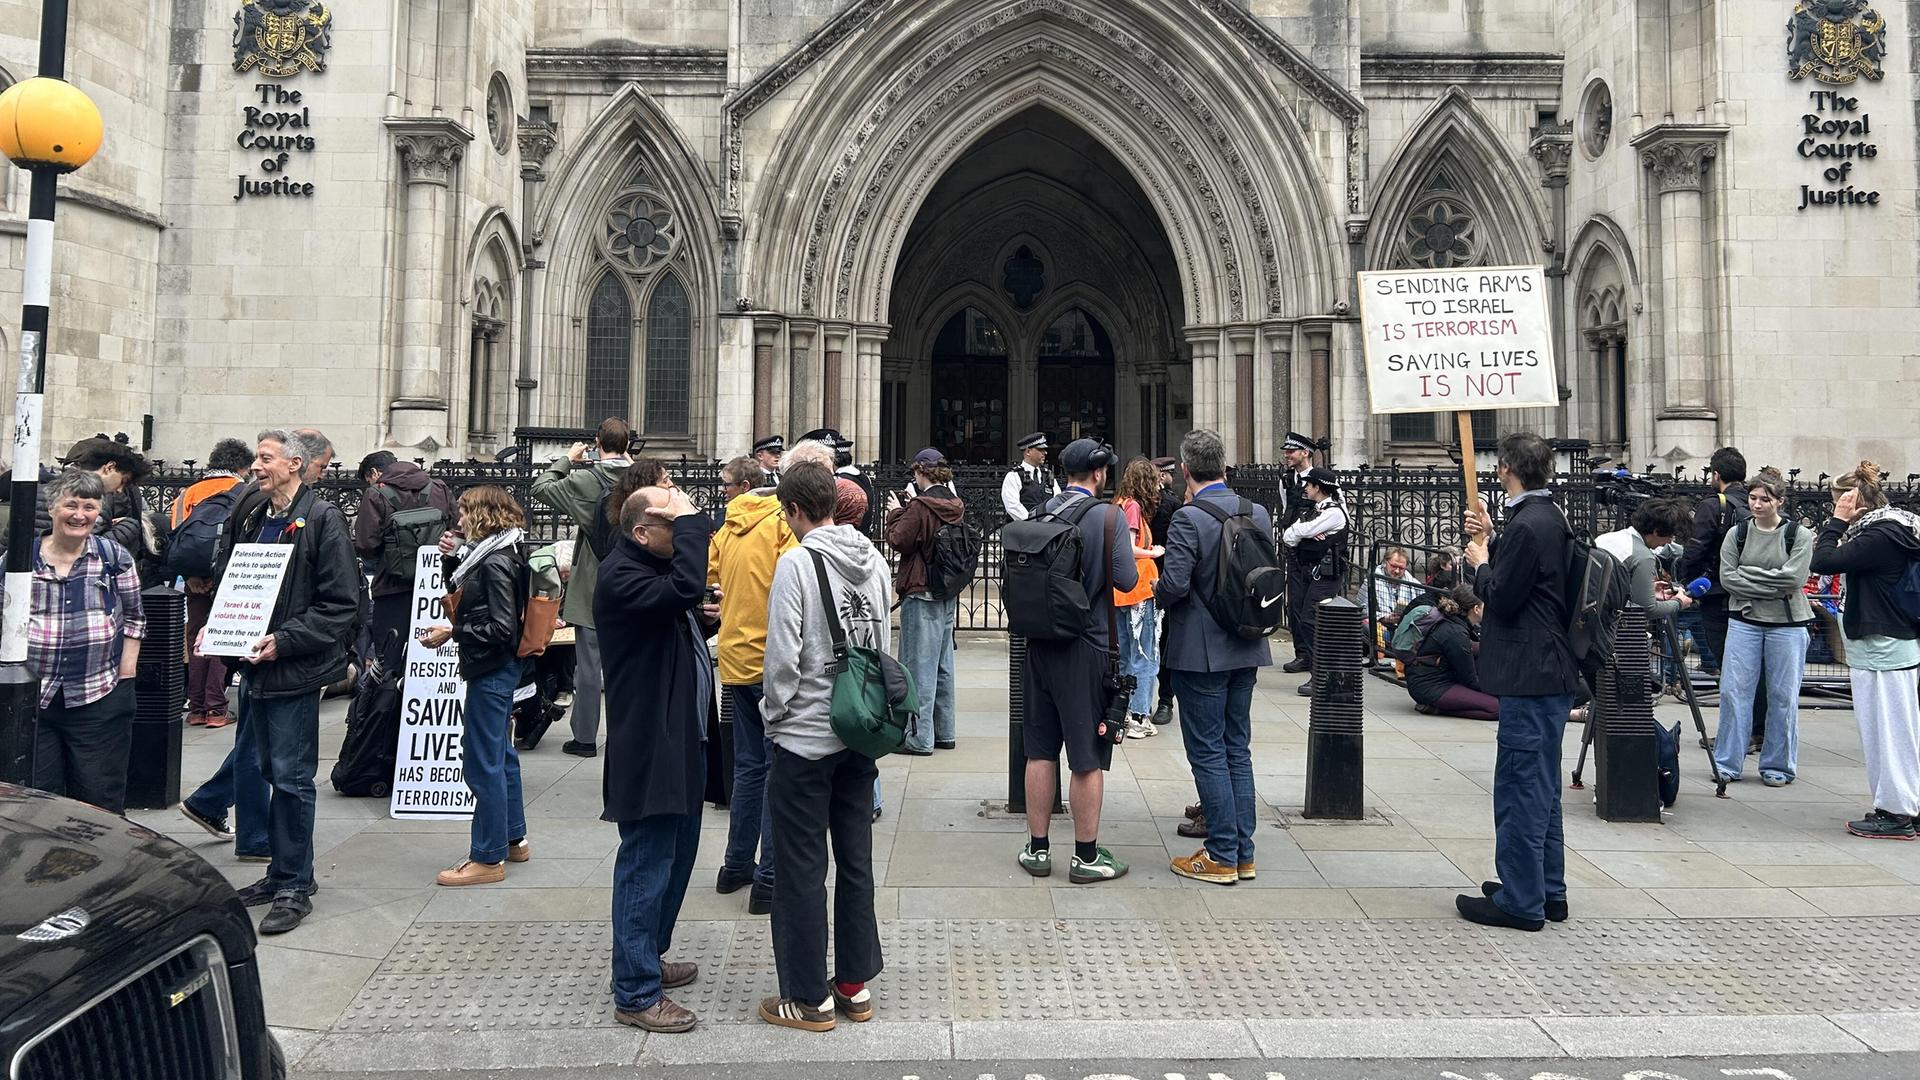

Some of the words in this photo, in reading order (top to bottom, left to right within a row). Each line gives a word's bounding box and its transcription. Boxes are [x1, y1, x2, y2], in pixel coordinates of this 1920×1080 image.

[255, 84, 302, 104] The
[1809, 90, 1858, 111] The
[243, 106, 310, 131] Royal
[1802, 113, 1871, 140] Royal
[237, 129, 315, 151] Courts
[1797, 137, 1878, 158] Courts
[261, 152, 289, 172] of
[1823, 161, 1853, 182] of
[233, 175, 315, 200] Justice
[1798, 185, 1881, 210] Justice
[1376, 277, 1470, 295] SENDING
[1479, 275, 1532, 293] ARMS
[1405, 300, 1436, 316] TO
[1443, 299, 1514, 314] ISRAEL
[1382, 323, 1406, 342] IS
[1412, 319, 1518, 339] TERRORISM
[1387, 352, 1471, 372] SAVING
[1481, 350, 1539, 368] LIVES
[1419, 374, 1451, 398] IS
[1466, 372, 1522, 397] NOT
[234, 550, 264, 558] Palestine
[260, 562, 282, 570] uphold
[233, 583, 264, 591] genocide.
[253, 573, 277, 581] against
[419, 578, 425, 589] A
[223, 601, 242, 609] Israel
[207, 627, 221, 635] Who
[212, 640, 247, 648] criminals?
[437, 682, 456, 694] AND
[405, 698, 465, 726] SAVIN
[399, 766, 424, 782] HAS
[430, 767, 464, 783] BECO
[397, 789, 474, 807] TERRORISM
